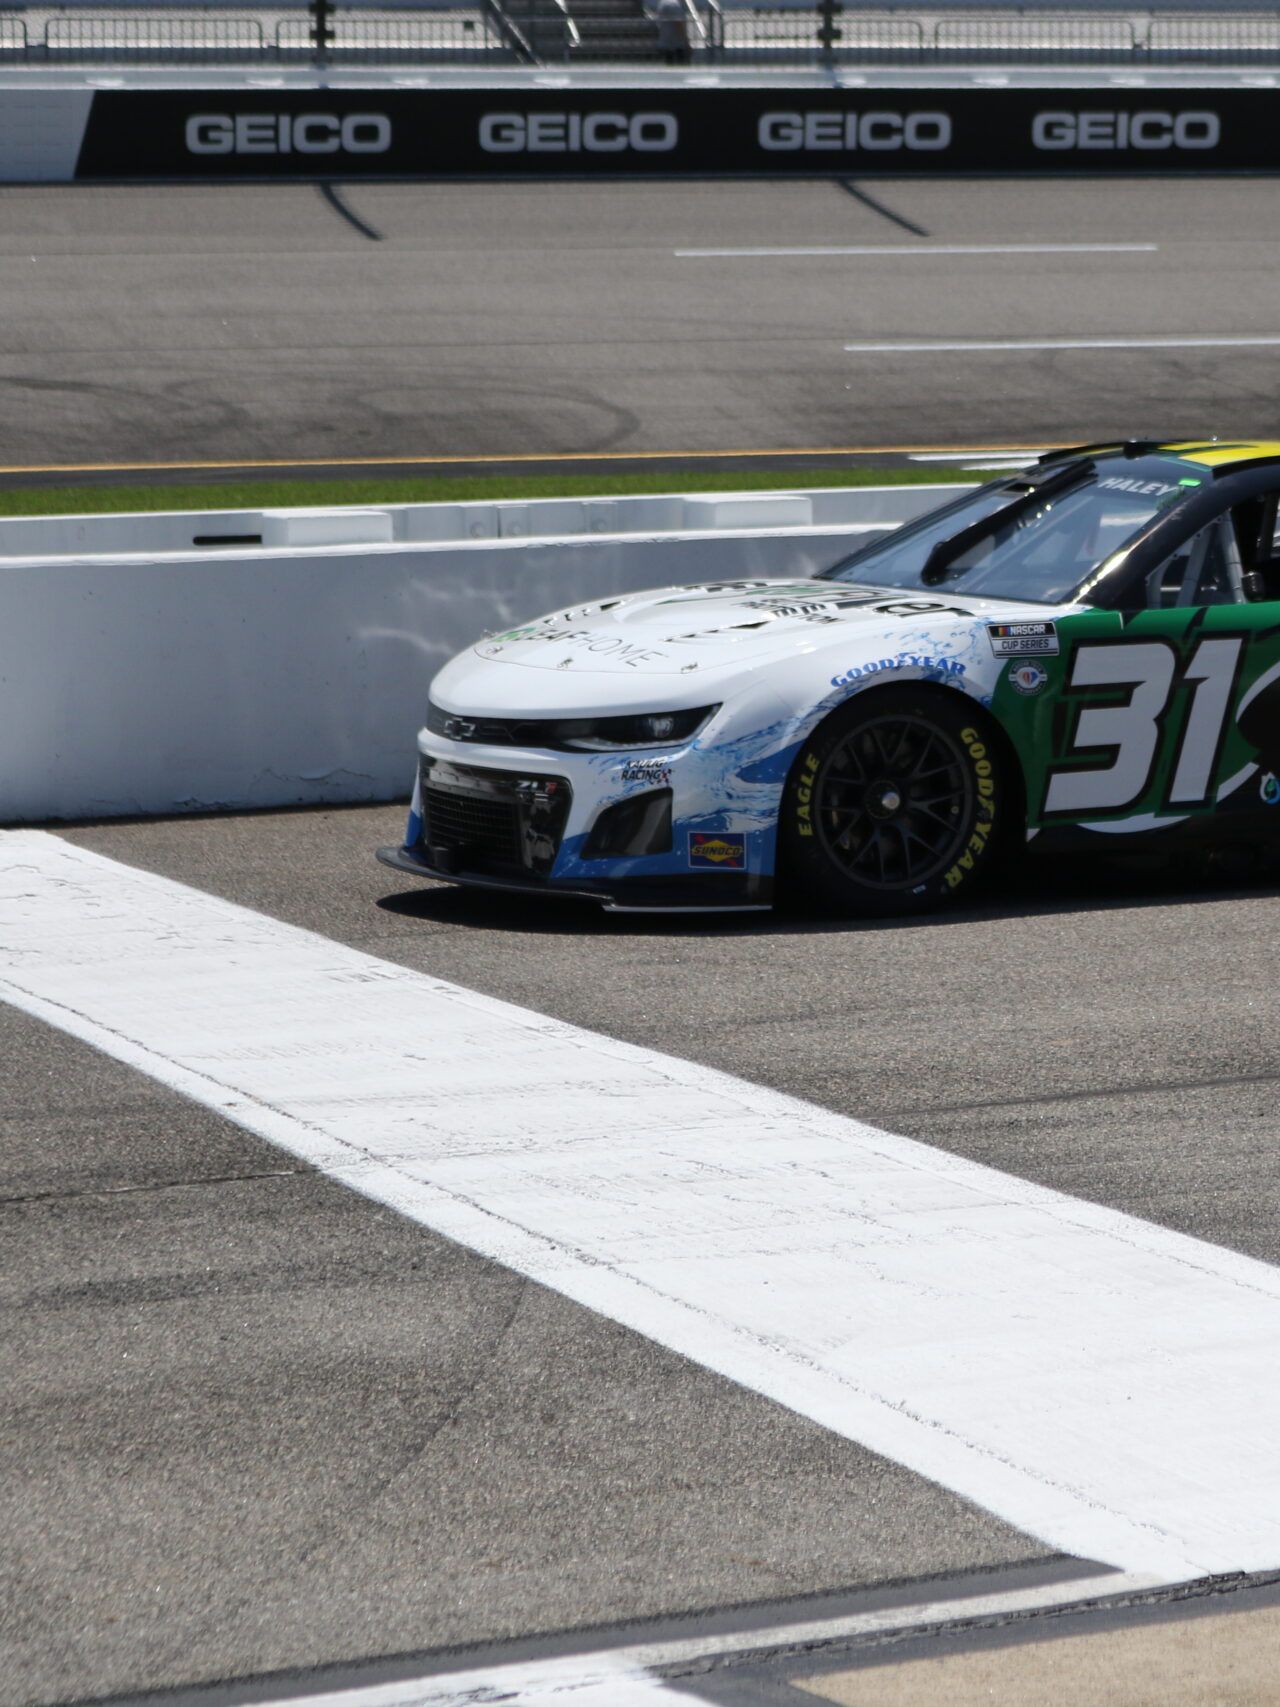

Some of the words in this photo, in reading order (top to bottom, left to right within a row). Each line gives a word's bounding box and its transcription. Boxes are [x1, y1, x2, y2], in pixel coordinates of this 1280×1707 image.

[187, 115, 390, 151] GEICO
[480, 114, 677, 150] GEICO
[760, 114, 950, 148] GEICO
[1033, 113, 1218, 148] GEICO
[1097, 477, 1179, 496] HALEY
[1001, 640, 1019, 650] CUP
[1019, 639, 1050, 650] SERIES
[1010, 624, 1046, 636] NASCAR
[830, 652, 967, 688] GOODYEAR
[1044, 637, 1243, 813] 31
[620, 769, 661, 781] RACING
[797, 752, 820, 837] EAGLE
[945, 727, 995, 888] GOODYEAR
[692, 845, 743, 858] SUNOCO
